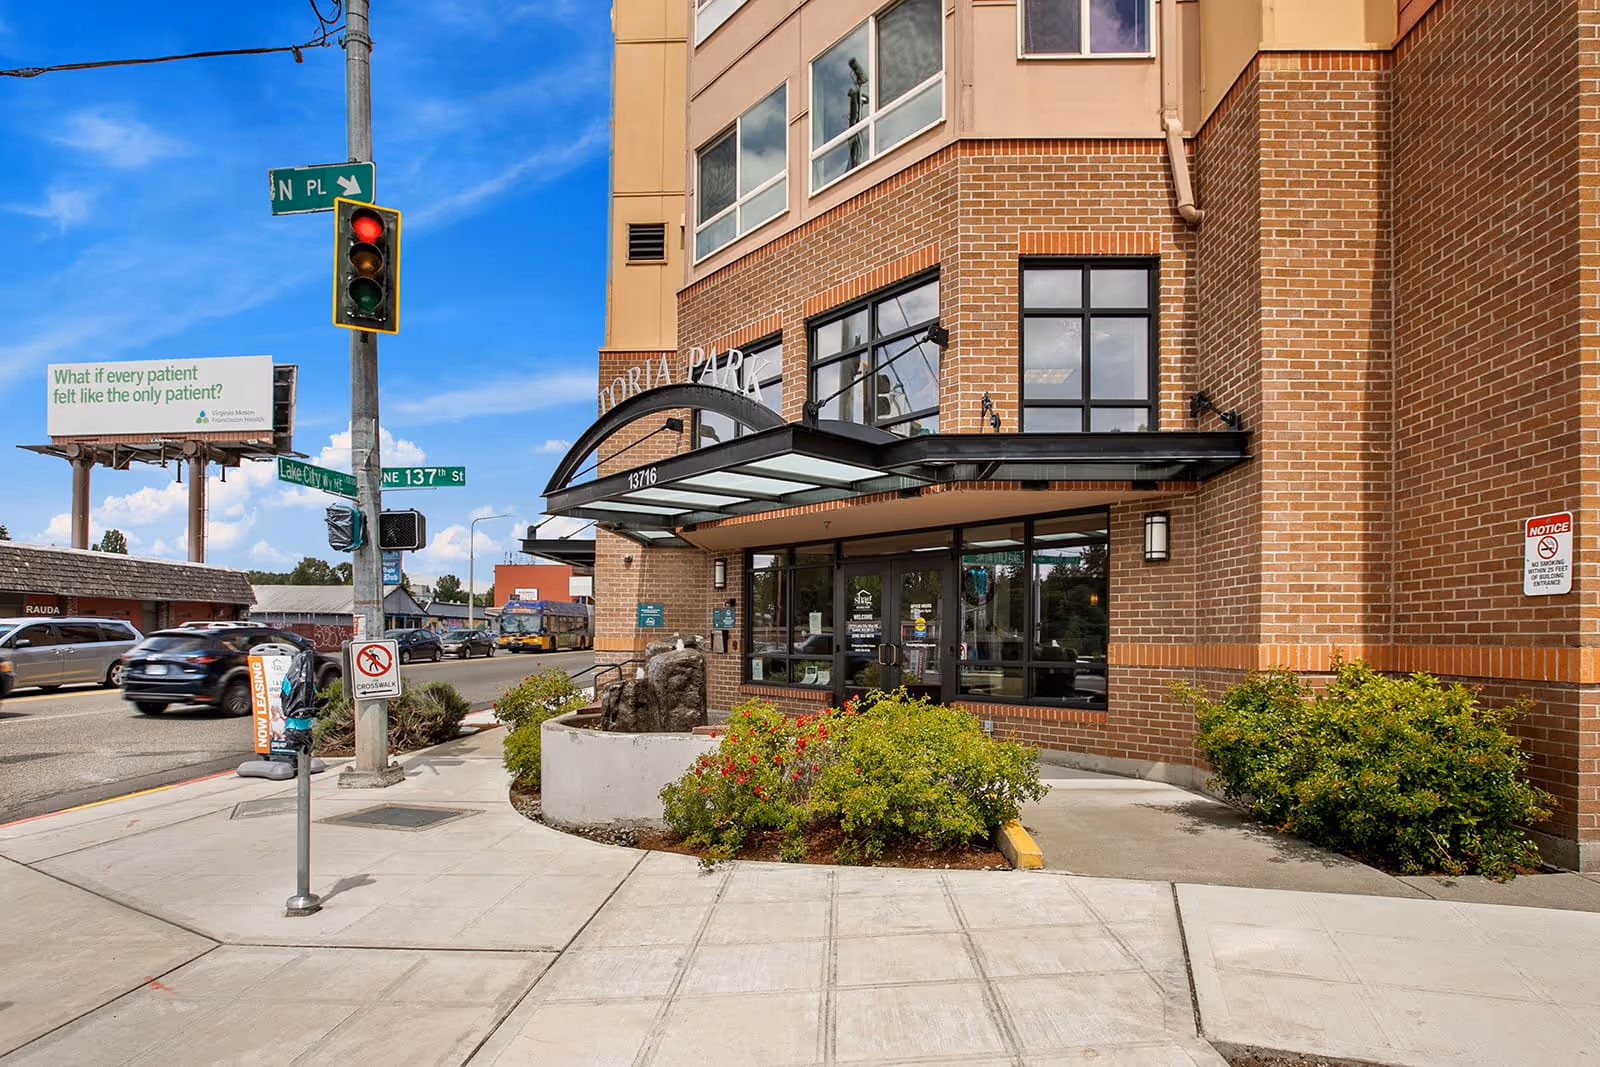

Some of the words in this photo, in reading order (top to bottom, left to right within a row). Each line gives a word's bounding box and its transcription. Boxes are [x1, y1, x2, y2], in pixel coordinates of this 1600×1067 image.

[279, 179, 293, 201] N
[306, 179, 327, 196] PL
[54, 369, 90, 385] What
[95, 367, 105, 384] if
[106, 370, 144, 386] every
[147, 365, 198, 386] patient
[686, 346, 771, 402] PARK
[53, 388, 76, 404] felt
[80, 387, 104, 403] like
[107, 387, 130, 402] the
[133, 385, 162, 405] only
[165, 383, 223, 404] patient?
[279, 458, 302, 481] Lake
[303, 465, 321, 488] City
[322, 474, 332, 490] Wy
[333, 478, 344, 491] NE
[383, 472, 400, 483] NE
[405, 467, 447, 485] 137th
[451, 470, 464, 482] St
[628, 467, 657, 489] 13716
[1530, 522, 1569, 536] NOTICE
[1528, 567, 1547, 575] WITHIN
[1555, 565, 1568, 573] FEET
[1540, 559, 1565, 567] SMOKING
[1533, 579, 1561, 587] ENTRANCE
[1539, 572, 1564, 580] BUILDING
[26, 604, 61, 615] RAUDA
[251, 662, 268, 715] LEASING
[356, 681, 397, 690] CROSSWALK
[257, 718, 268, 748] NOW
